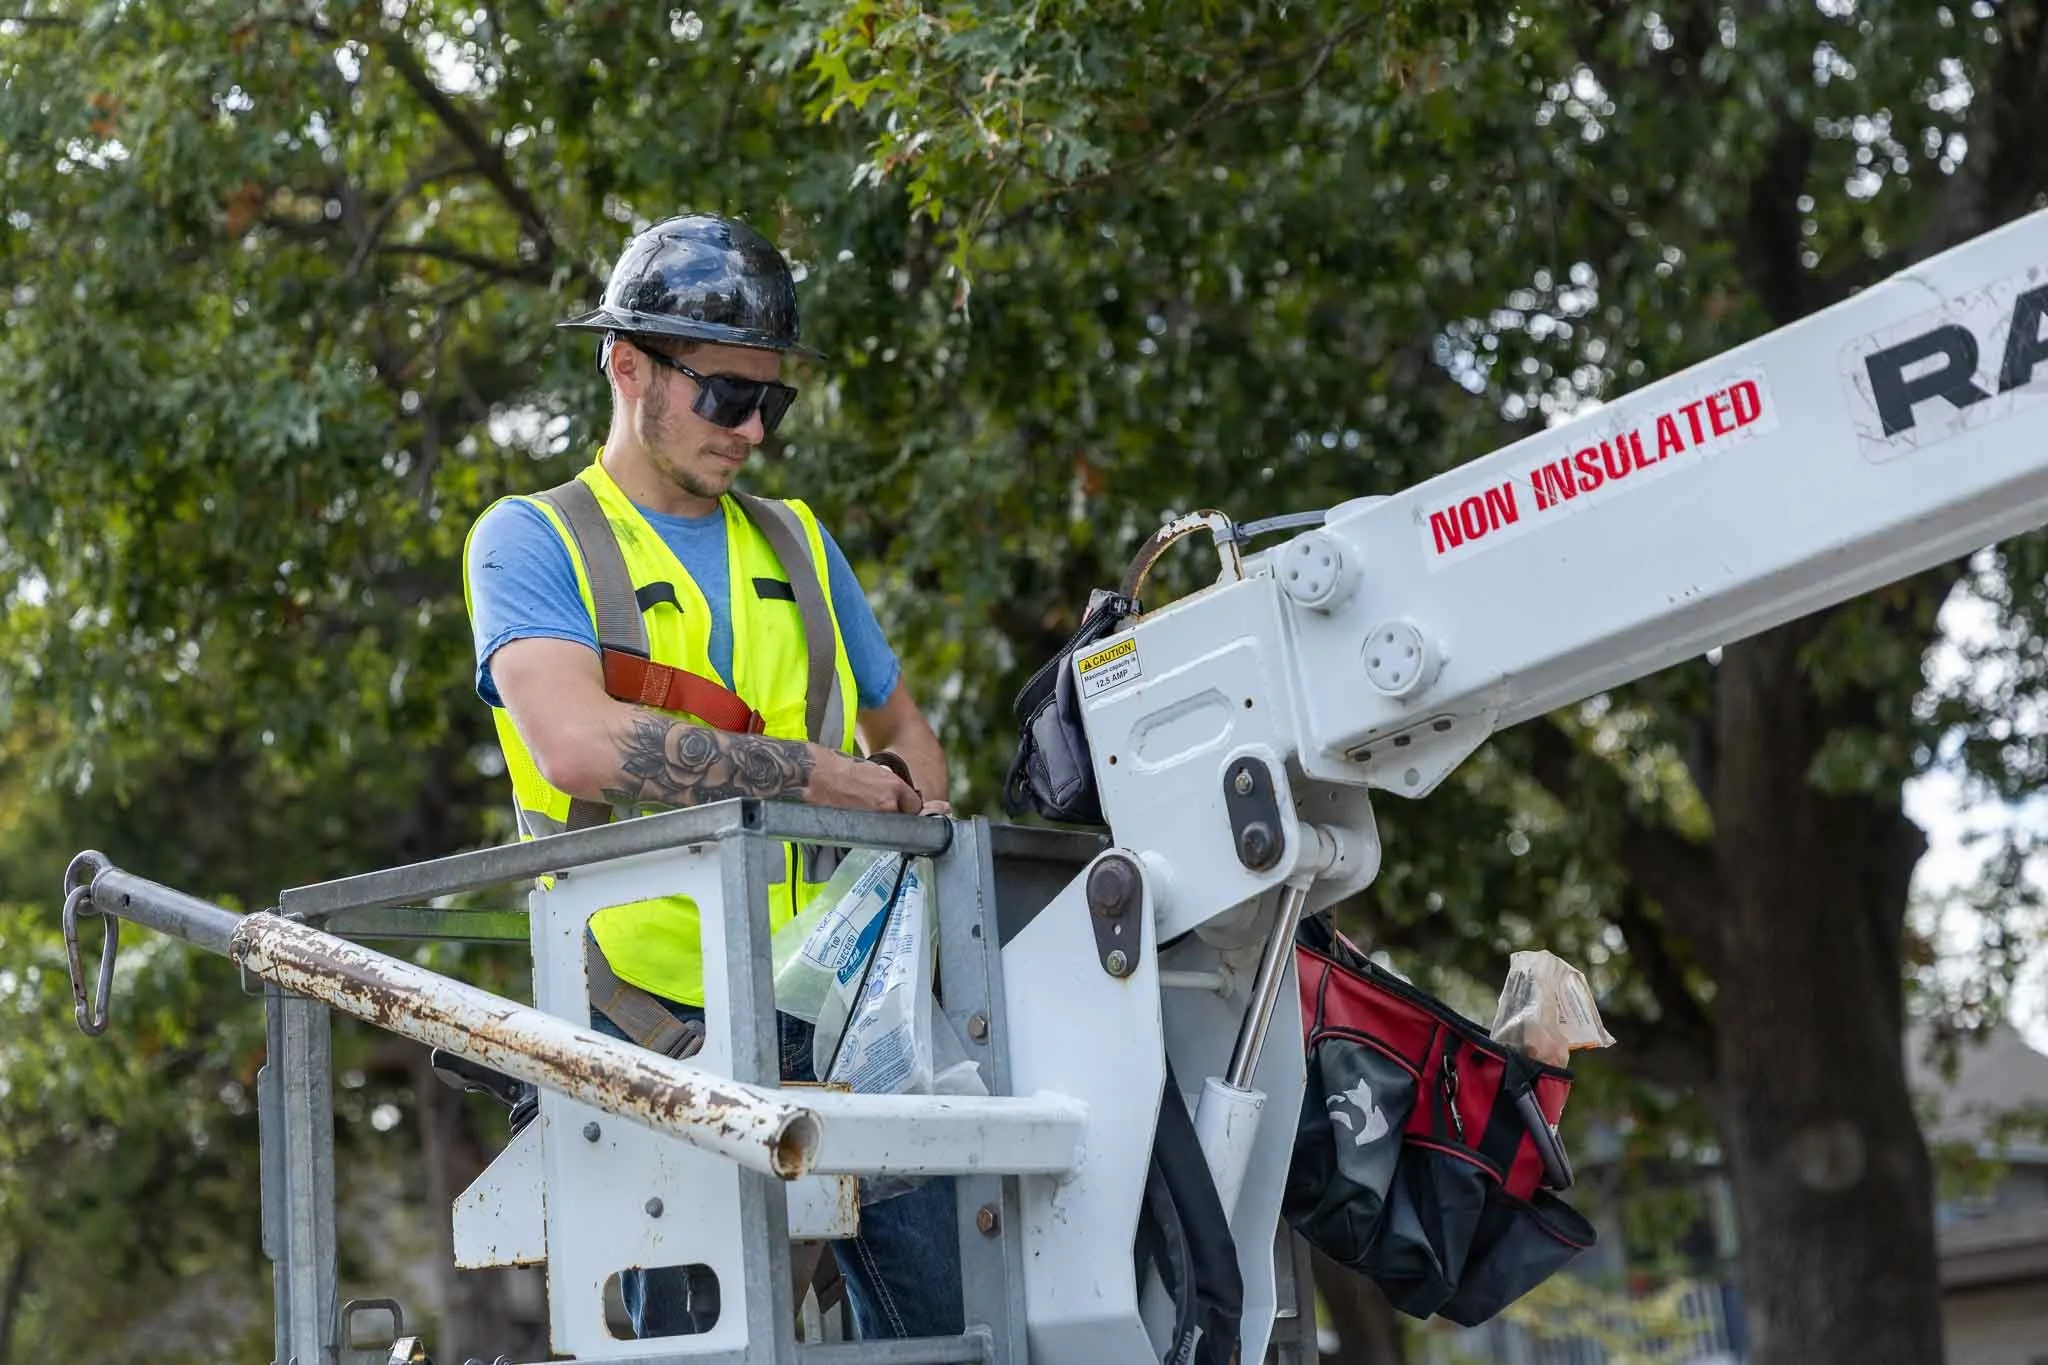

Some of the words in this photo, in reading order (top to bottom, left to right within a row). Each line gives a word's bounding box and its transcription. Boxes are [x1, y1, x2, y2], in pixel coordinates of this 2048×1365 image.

[1429, 481, 1520, 555] NON
[1529, 379, 1763, 512] INSULATED
[1092, 643, 1131, 665] CAUTION
[1084, 668, 1108, 681] Maximum
[1109, 659, 1130, 672] capacity
[1096, 677, 1110, 688] 12.5
[1111, 670, 1128, 681] AMP
[831, 935, 842, 949] 100
